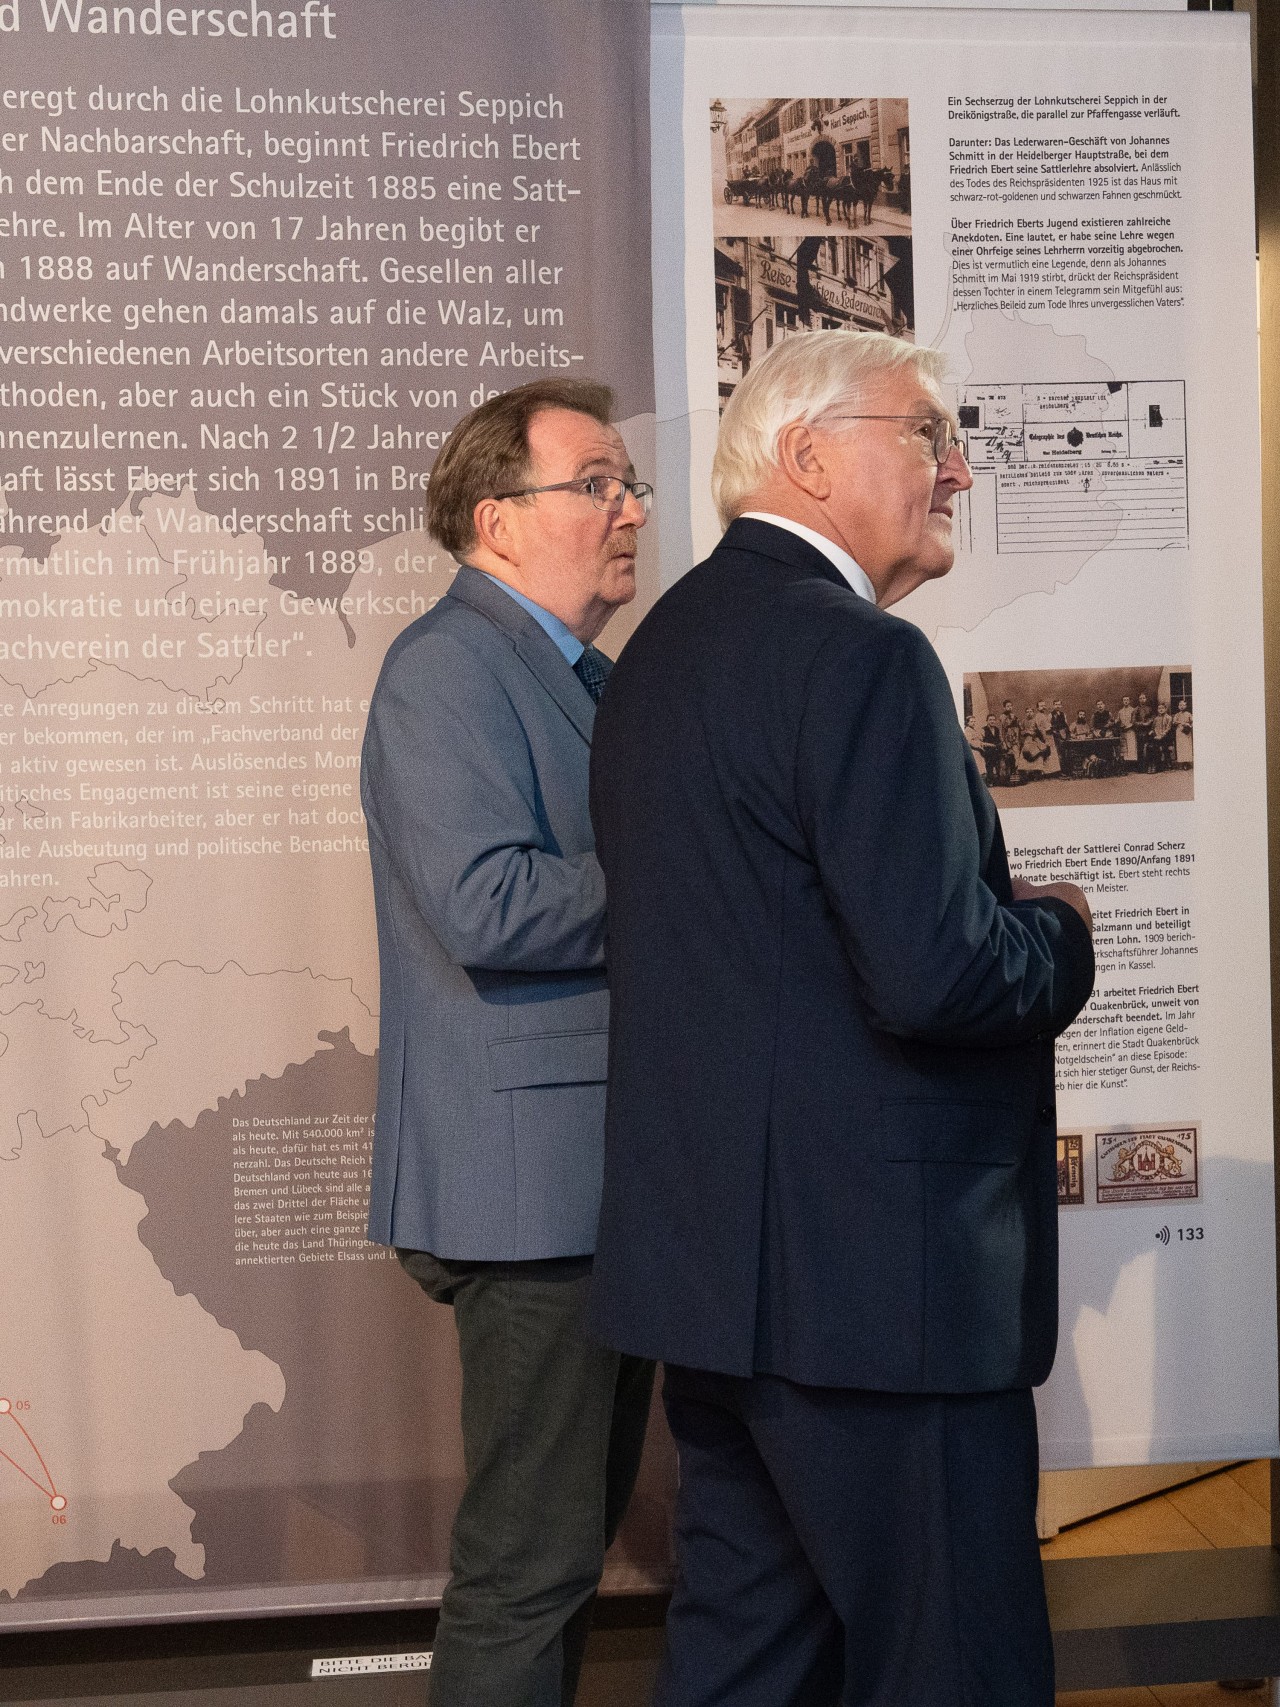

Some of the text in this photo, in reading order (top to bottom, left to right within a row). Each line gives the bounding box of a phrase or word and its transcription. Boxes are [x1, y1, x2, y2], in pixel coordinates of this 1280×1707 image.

[40, 0, 336, 39] Wanderschaft
[87, 83, 564, 124] durch die Lohnkutscherei Seppich
[947, 94, 1167, 108] Ein Sechserzug der Lohnkutscherei Seppich in der
[947, 109, 1019, 122] Dreikönigstraße,
[1020, 109, 1034, 119] die
[1035, 109, 1068, 121] parallel
[1086, 108, 1142, 120] Pfaffengasse
[1143, 107, 1180, 118] verläuft.
[40, 125, 581, 164] Nachbarschaft, beginnt Friedrich Ebert
[948, 148, 1169, 162] Schmitt in der Heidelberger Hauptstraße, bei dem
[949, 162, 1181, 174] Friedrich Ebert seine Sattlerlehre absolviert. Anlässlich
[24, 168, 581, 202] dem Ende der Schulzeit 1885 eine Satt-
[78, 211, 540, 249] Im Alter von 17 Jahren begibt er
[950, 216, 1170, 230] Über Friedrich Eberts Jugend existieren zahlreiche
[951, 243, 1183, 257] einer Ohrfeige seines Lehrherrn vorzeitig abgebrochen.
[0, 338, 584, 368] verschiedenen Arbeitsorten andere Arbeits-
[200, 420, 355, 454] Nach 2 1/2
[21, 694, 352, 721] Anregungen zu diesem Schritt hat
[23, 726, 128, 746] bekommen,
[134, 725, 164, 743] der
[171, 724, 194, 743] im
[329, 722, 359, 741] der
[78, 779, 352, 806] Engagement ist seine eigene
[37, 835, 282, 862] Ausbeutung und politische
[1013, 840, 1185, 858] Belegschaft der Sattlerei Conrad Scherz
[1009, 853, 1194, 870] wo Friedrich Ebert Ende 1890/Anfang 1891
[1114, 905, 1189, 918] Friedrich Ebert in
[1135, 919, 1190, 930] und beteiligt
[1103, 983, 1199, 997] arbeitet Friedrich Ebert
[1150, 997, 1180, 1008] unweit
[1182, 998, 1199, 1006] von
[1062, 1068, 1079, 1077] sich
[1080, 1067, 1096, 1076] hier
[1098, 1067, 1128, 1077] stetiger
[1156, 1063, 1169, 1072] der
[232, 1113, 368, 1127] Das Deutschland zur Zeit der
[232, 1131, 246, 1141] als
[248, 1131, 279, 1140] heute.
[282, 1129, 299, 1139] Mit
[302, 1127, 343, 1138] 540.000
[232, 1154, 365, 1168] nerzahl. Das Deutsche Reich
[233, 1182, 362, 1197] Bremen und Lübeck sind alle
[1177, 1227, 1204, 1241] 133
[234, 1250, 385, 1265] annektierten Gebiete Elsass und
[16, 1400, 31, 1411] 05
[52, 1514, 67, 1525] 06
[319, 1665, 372, 1674] NICHT
